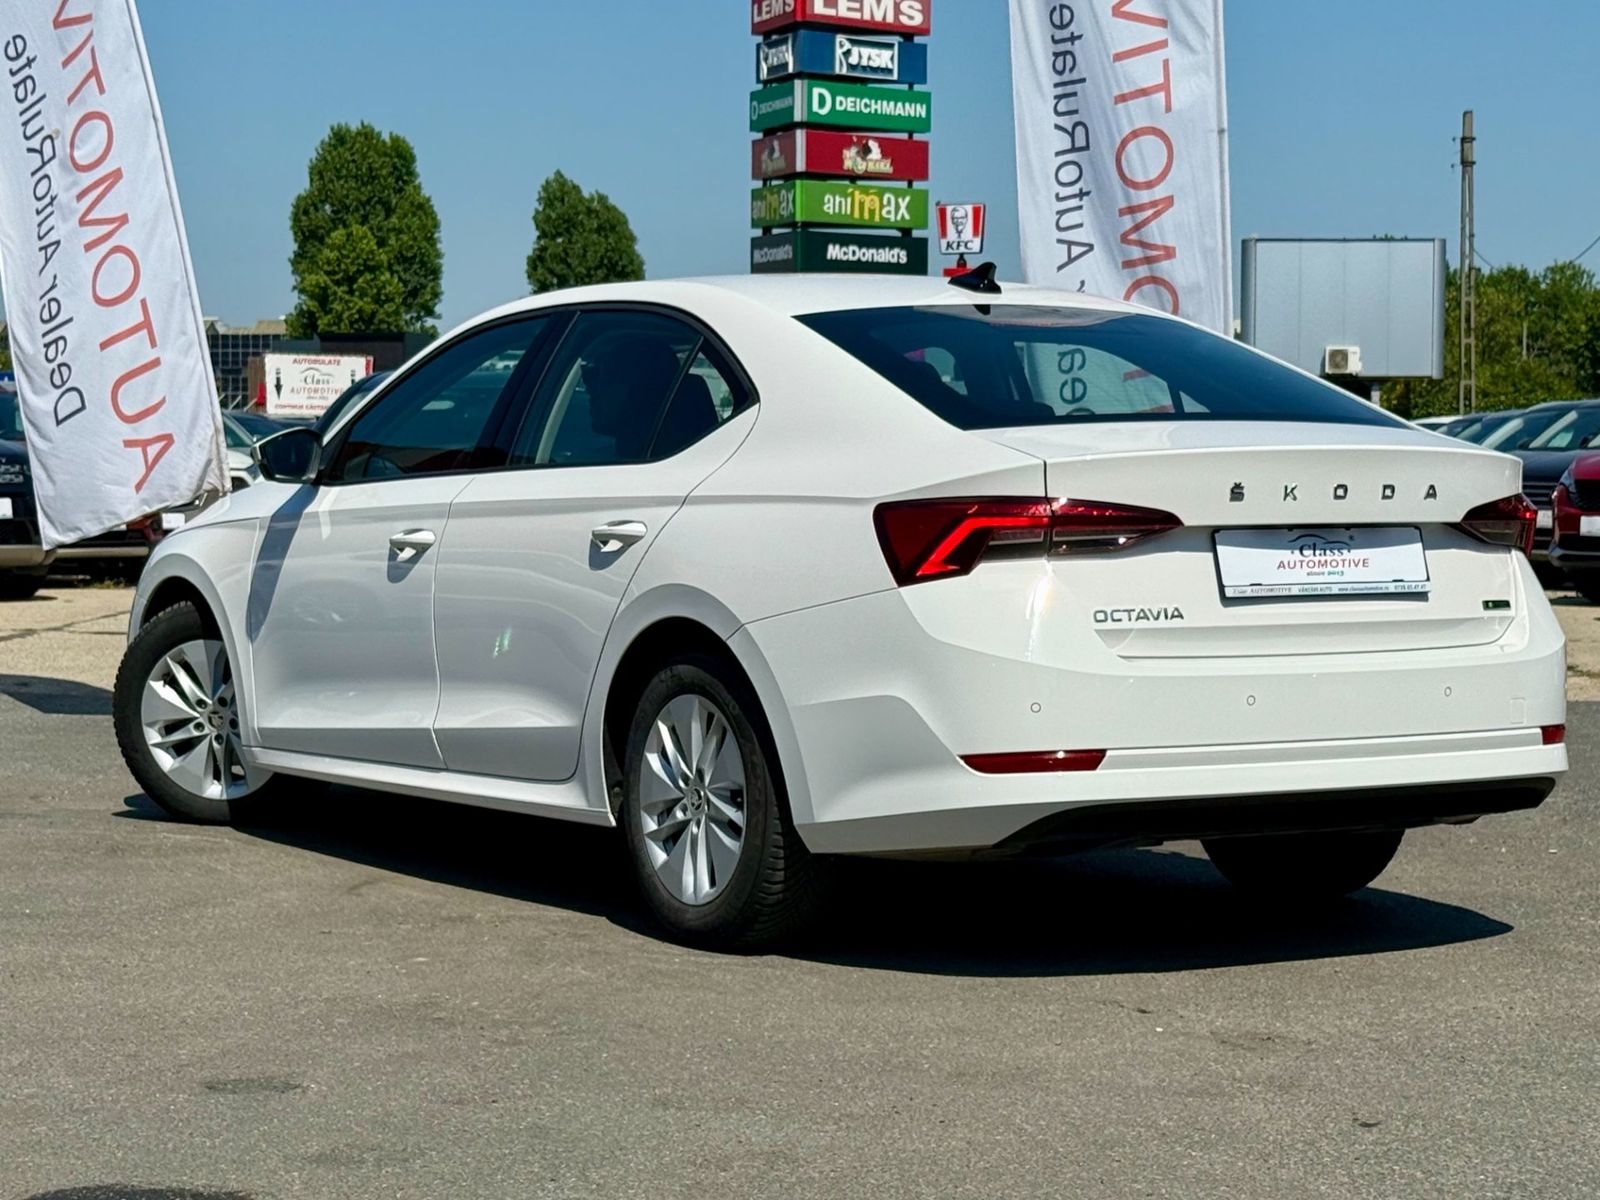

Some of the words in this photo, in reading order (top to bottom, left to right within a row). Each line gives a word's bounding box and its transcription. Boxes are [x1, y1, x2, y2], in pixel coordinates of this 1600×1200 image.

[813, 0, 924, 27] LEMS
[848, 47, 894, 69] JYSK
[835, 96, 926, 118] DEICHMANN
[823, 189, 911, 222] animax
[827, 244, 907, 264] McDonald's
[945, 240, 975, 251] KFC
[1298, 542, 1345, 558] Class
[1277, 558, 1370, 571] AUTOMOTIVE
[1093, 607, 1185, 624] OCTAVIA
